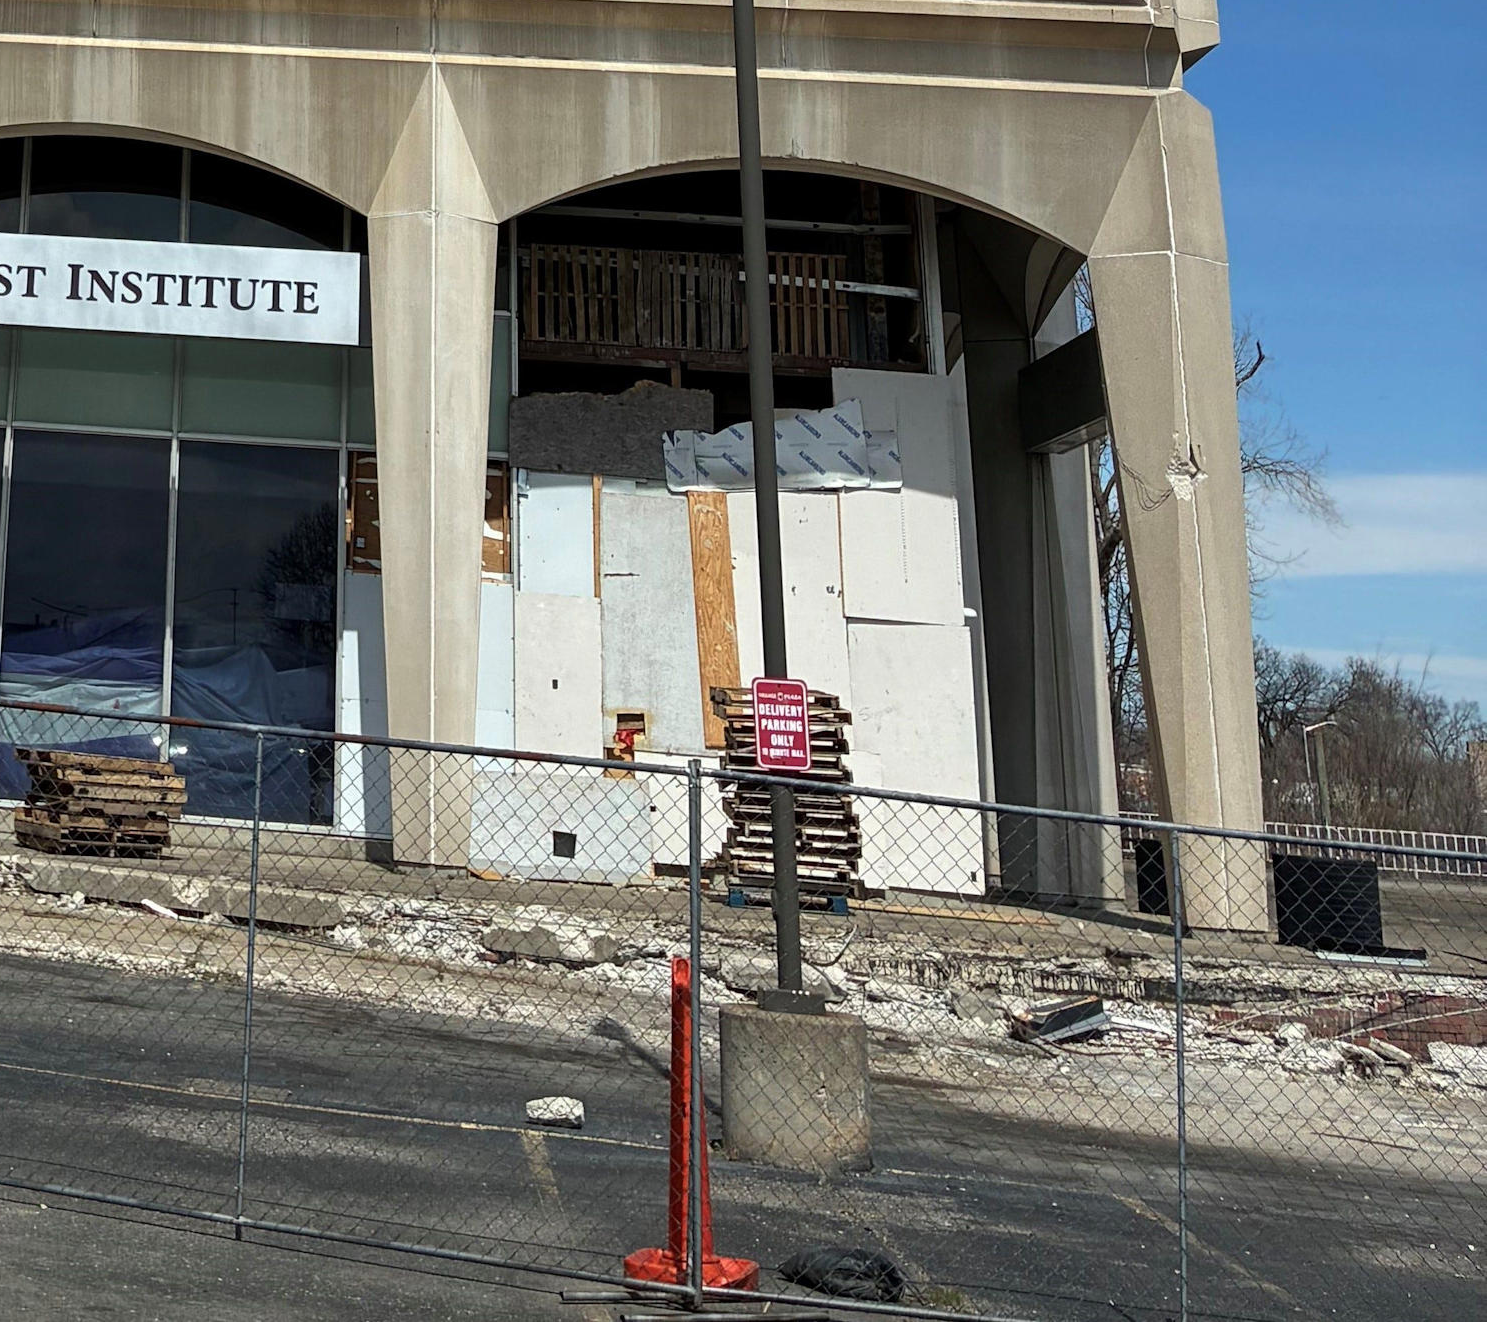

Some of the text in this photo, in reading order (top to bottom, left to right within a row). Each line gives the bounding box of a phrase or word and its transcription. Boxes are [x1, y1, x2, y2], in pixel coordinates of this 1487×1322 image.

[65, 263, 320, 315] INSTITUTE
[758, 703, 803, 718] DELIVERY
[760, 718, 804, 732] PARKING
[770, 734, 795, 747] ONLY
